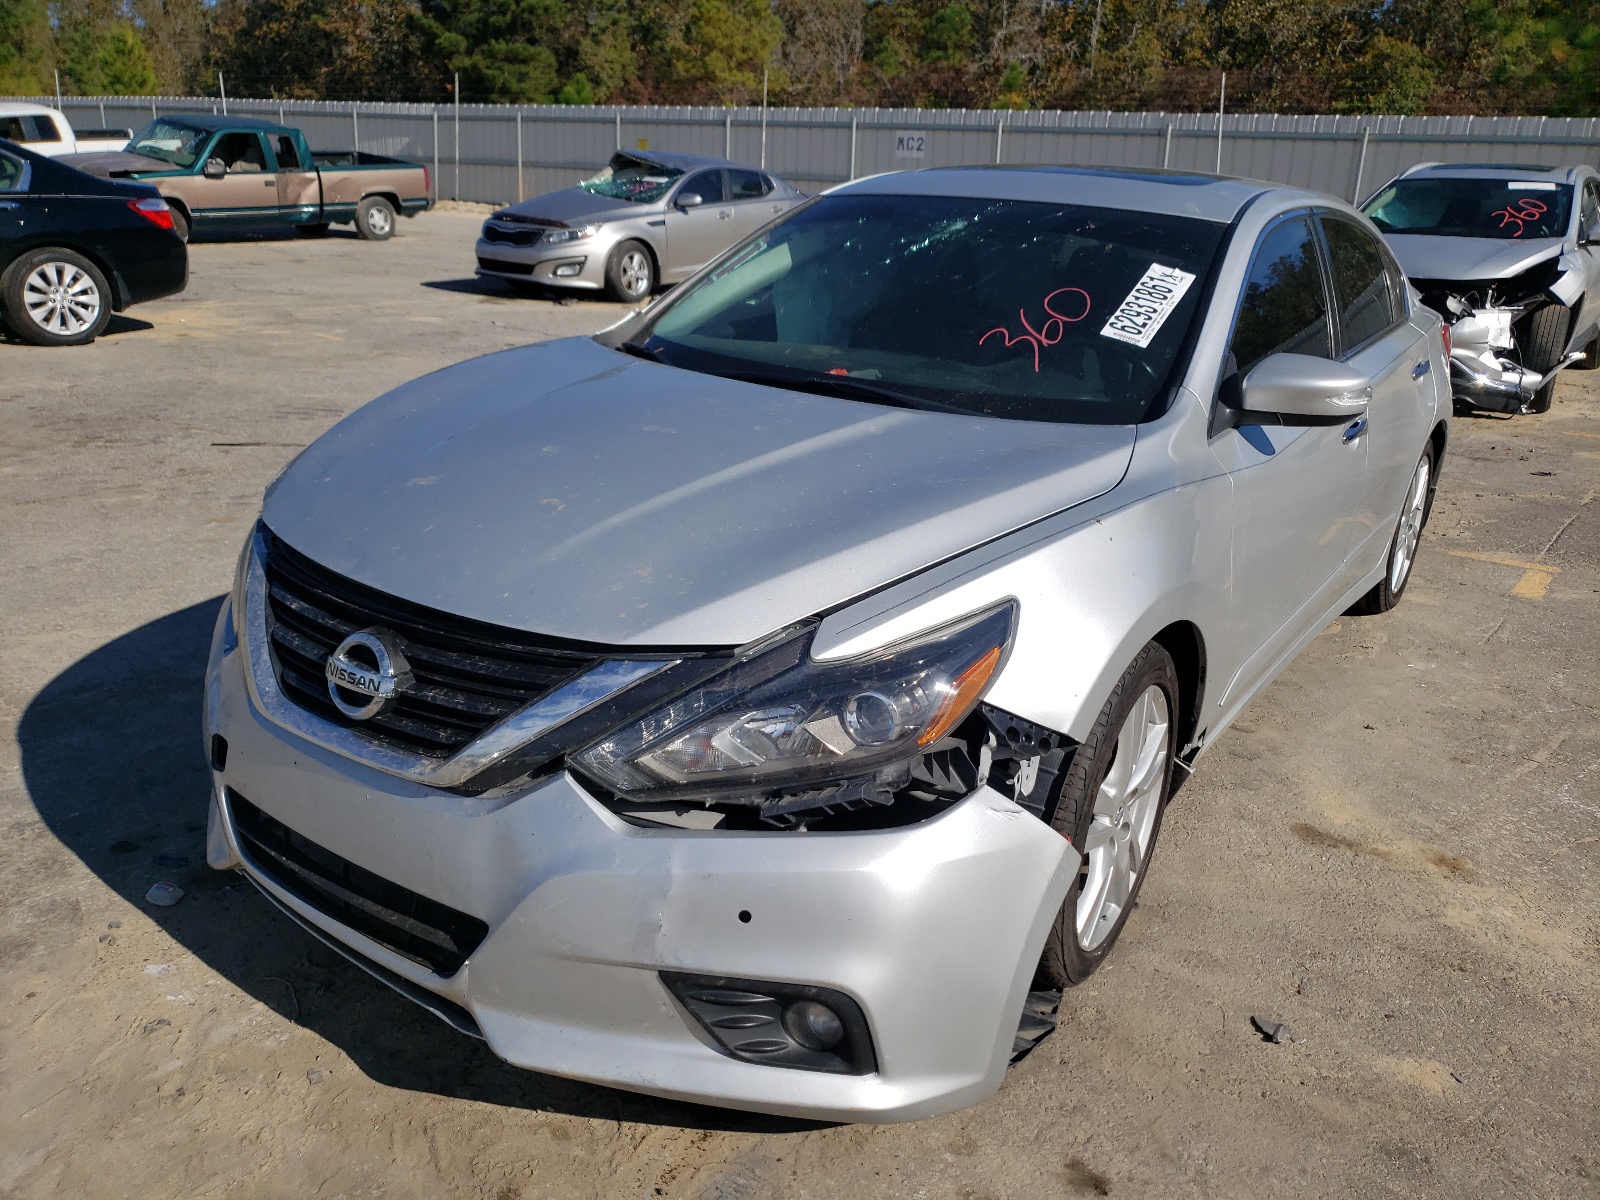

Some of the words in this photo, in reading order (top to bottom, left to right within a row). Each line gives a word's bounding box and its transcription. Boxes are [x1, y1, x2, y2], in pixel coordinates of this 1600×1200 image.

[896, 136, 924, 151] MC2
[1491, 198, 1548, 238] 360
[1109, 275, 1178, 335] 62931861
[979, 287, 1091, 373] 360
[326, 661, 381, 693] NISSAN
